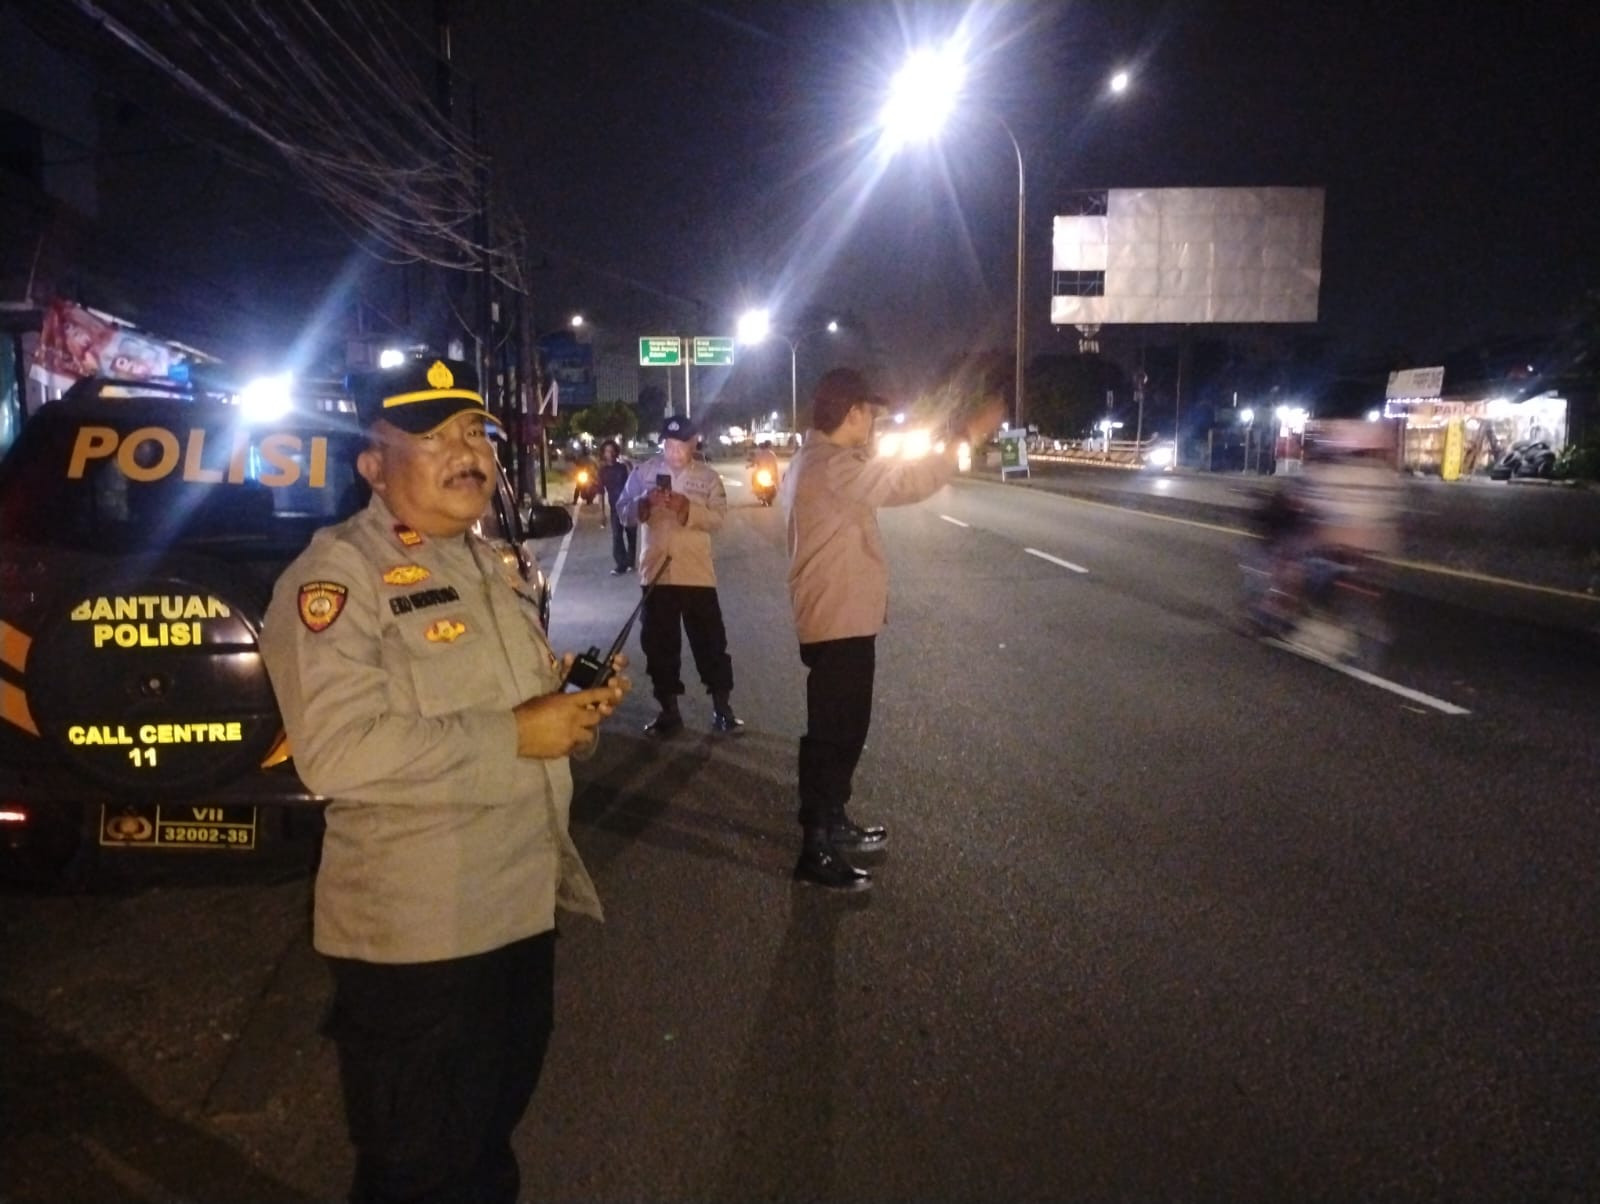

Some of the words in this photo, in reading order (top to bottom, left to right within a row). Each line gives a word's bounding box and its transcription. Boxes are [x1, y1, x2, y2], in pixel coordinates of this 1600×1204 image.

[67, 426, 328, 488] POLISI
[94, 622, 202, 647] POLISI
[68, 725, 133, 745] CALL
[139, 722, 242, 743] CENTRE
[128, 747, 157, 767] 11
[192, 807, 224, 821] VII
